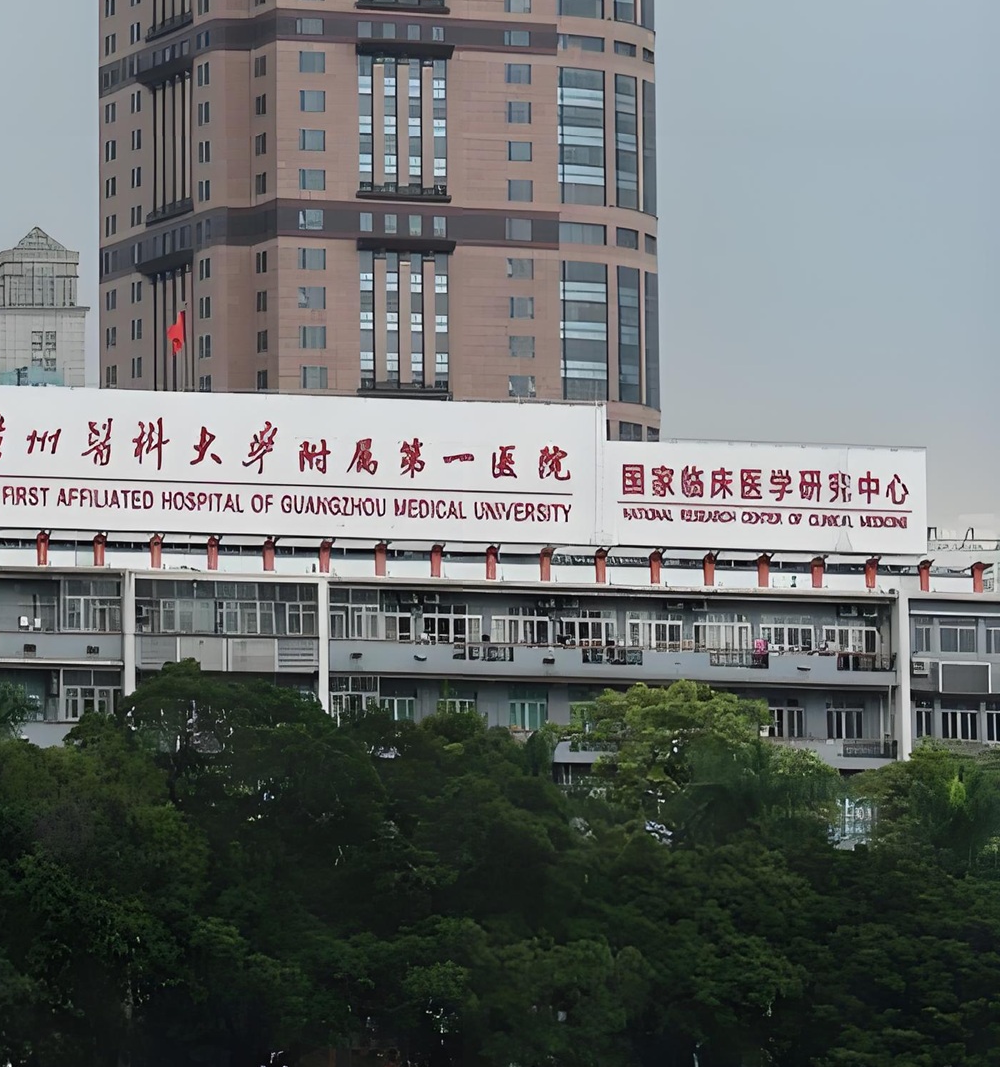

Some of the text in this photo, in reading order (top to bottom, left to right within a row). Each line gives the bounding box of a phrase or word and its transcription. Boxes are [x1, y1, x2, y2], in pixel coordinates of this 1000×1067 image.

[622, 464, 909, 505] 国家临床医学研究中心
[2, 486, 50, 507] FIRST
[57, 488, 154, 510] AFFILIATED
[161, 491, 244, 513] HOSPITAL
[251, 494, 274, 514] OF
[281, 495, 386, 517] GUANGZHOU
[394, 498, 467, 520] MEDICAL
[474, 501, 572, 523] UNIVERSITY
